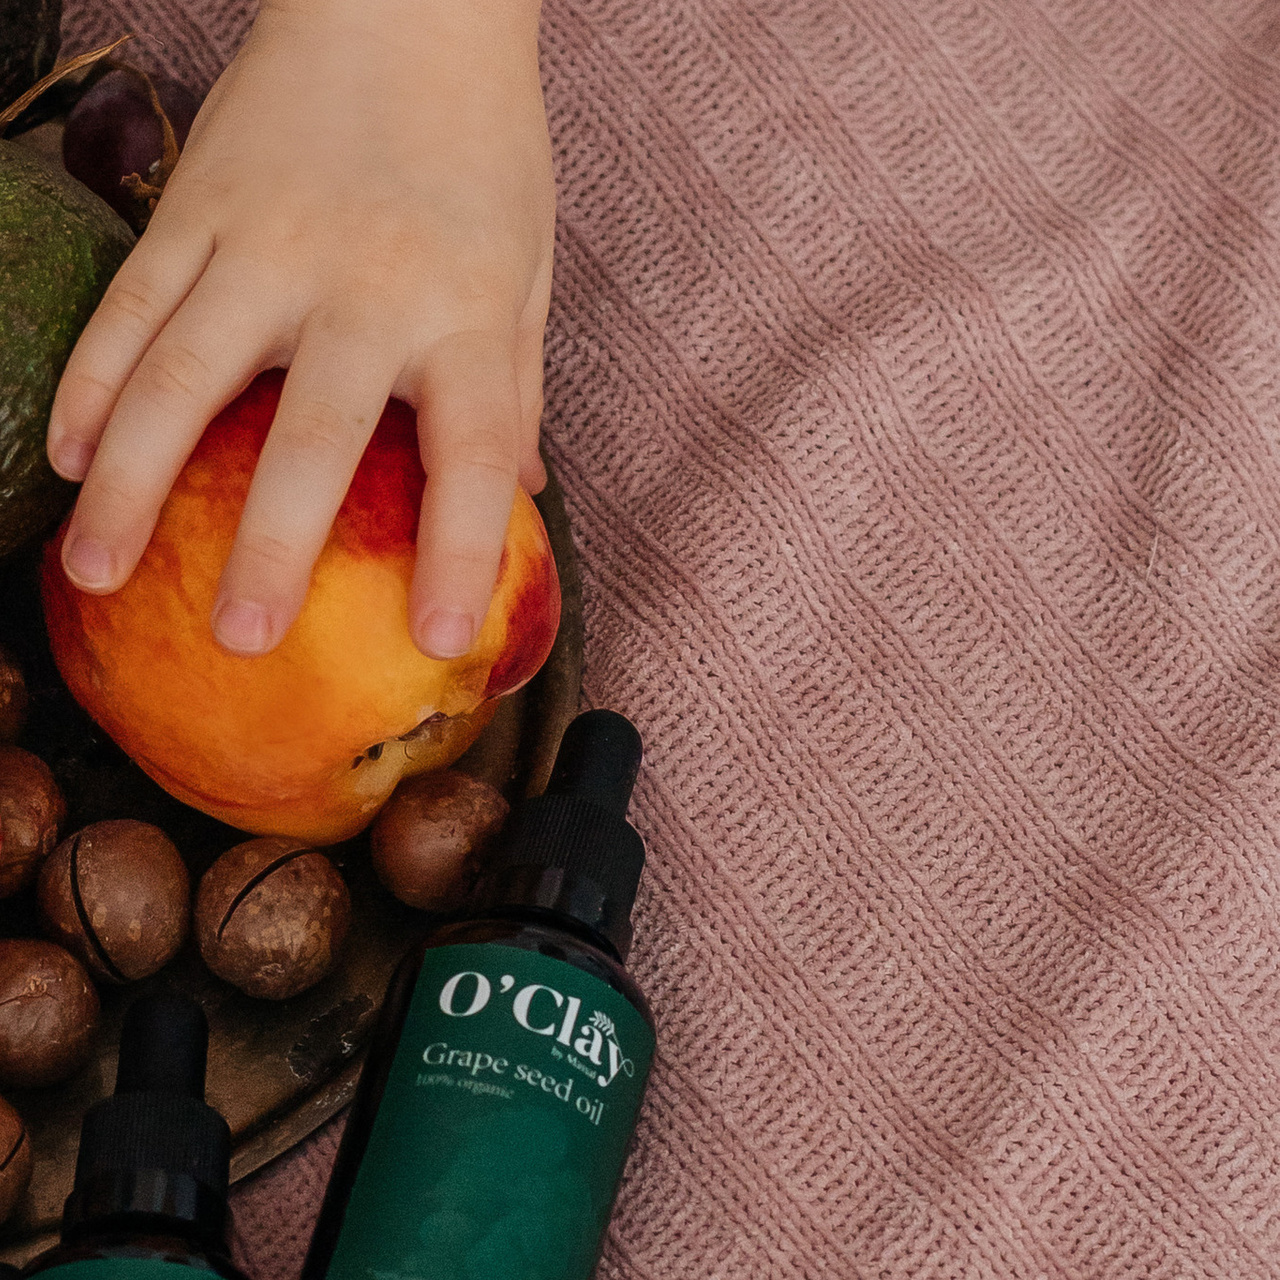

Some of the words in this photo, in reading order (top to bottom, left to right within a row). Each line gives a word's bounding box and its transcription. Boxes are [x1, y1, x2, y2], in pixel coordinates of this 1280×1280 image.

[438, 970, 634, 1088] O'Clay
[422, 1041, 509, 1076] Grape
[513, 1063, 574, 1103] seed
[575, 1095, 605, 1126] oil
